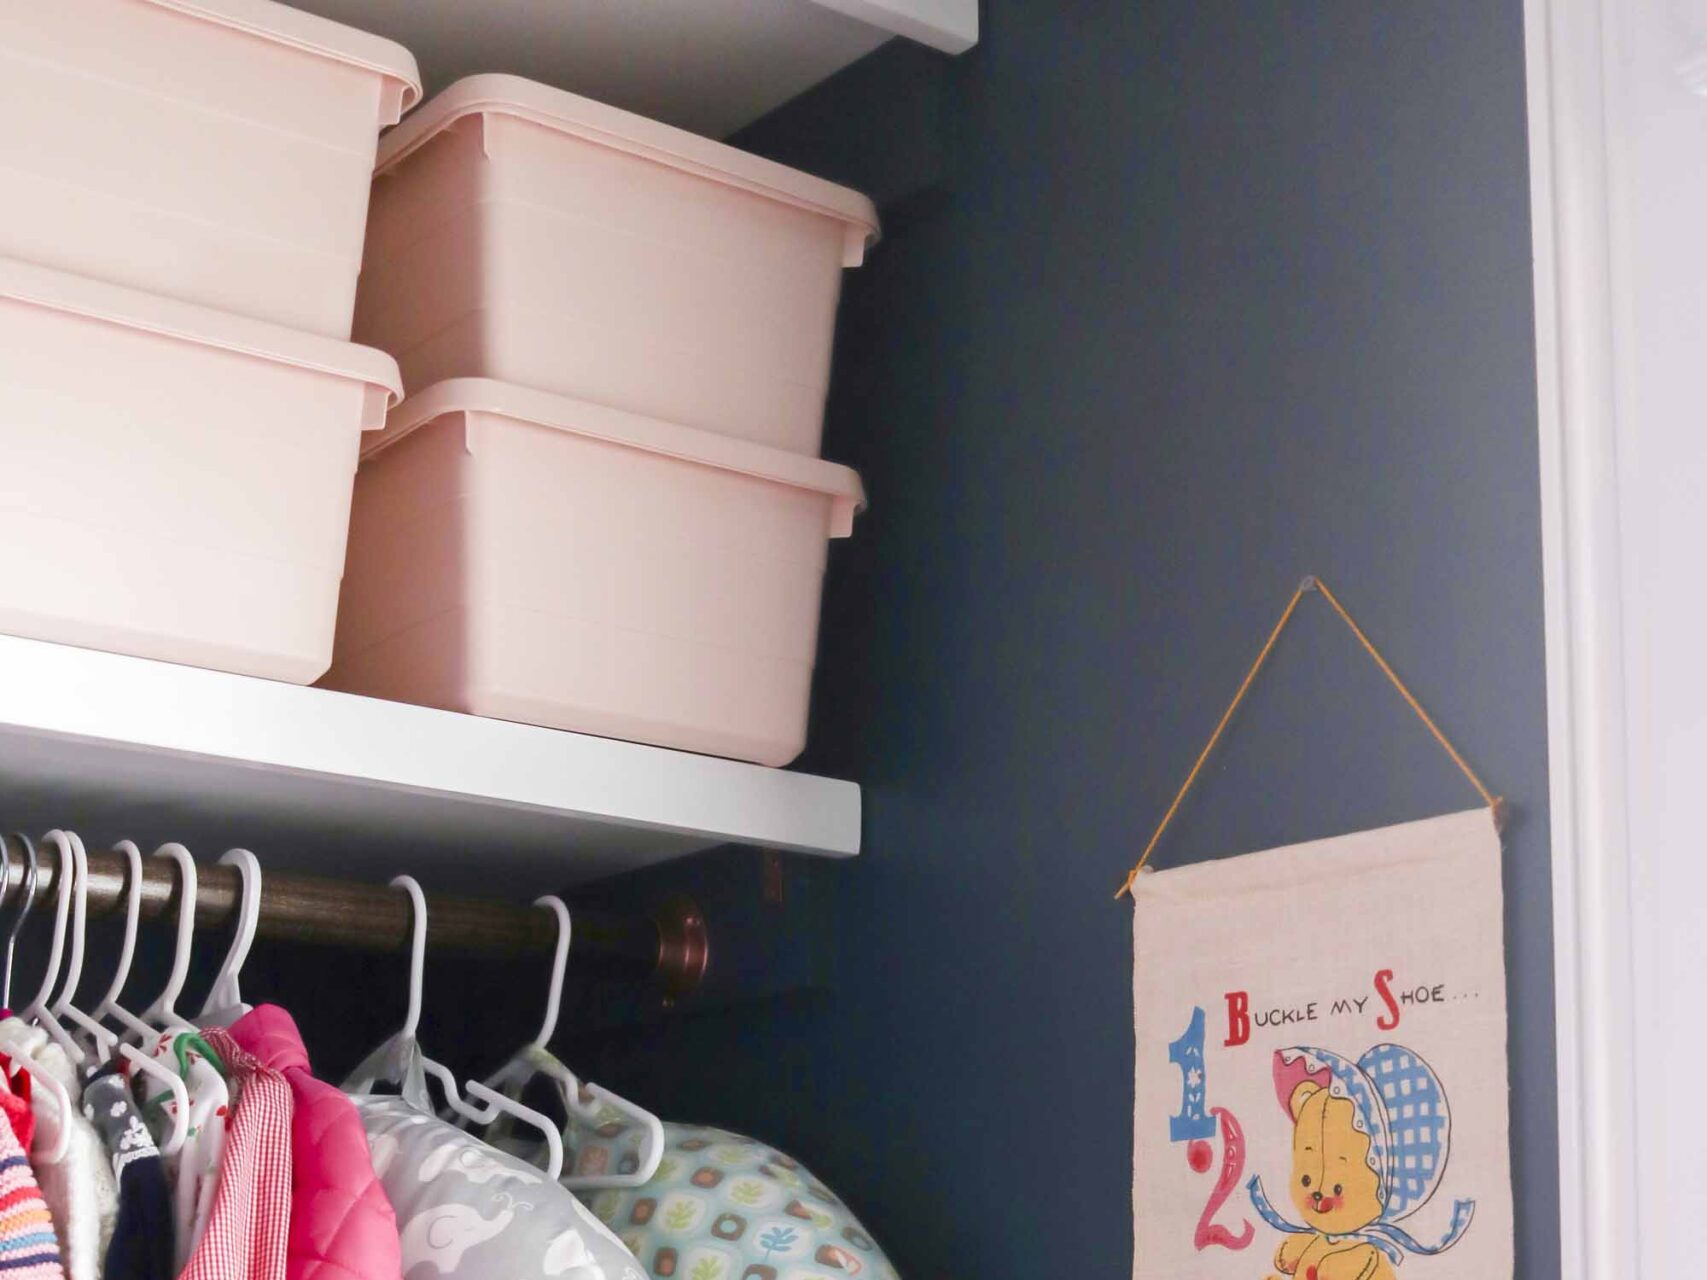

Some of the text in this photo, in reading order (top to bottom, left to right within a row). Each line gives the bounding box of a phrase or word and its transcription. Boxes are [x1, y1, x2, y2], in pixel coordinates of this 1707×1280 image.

[1168, 1005, 1217, 1142] 1
[1224, 991, 1318, 1047] BUCKLE
[1330, 997, 1368, 1016] MY
[1187, 1107, 1255, 1250] 2
